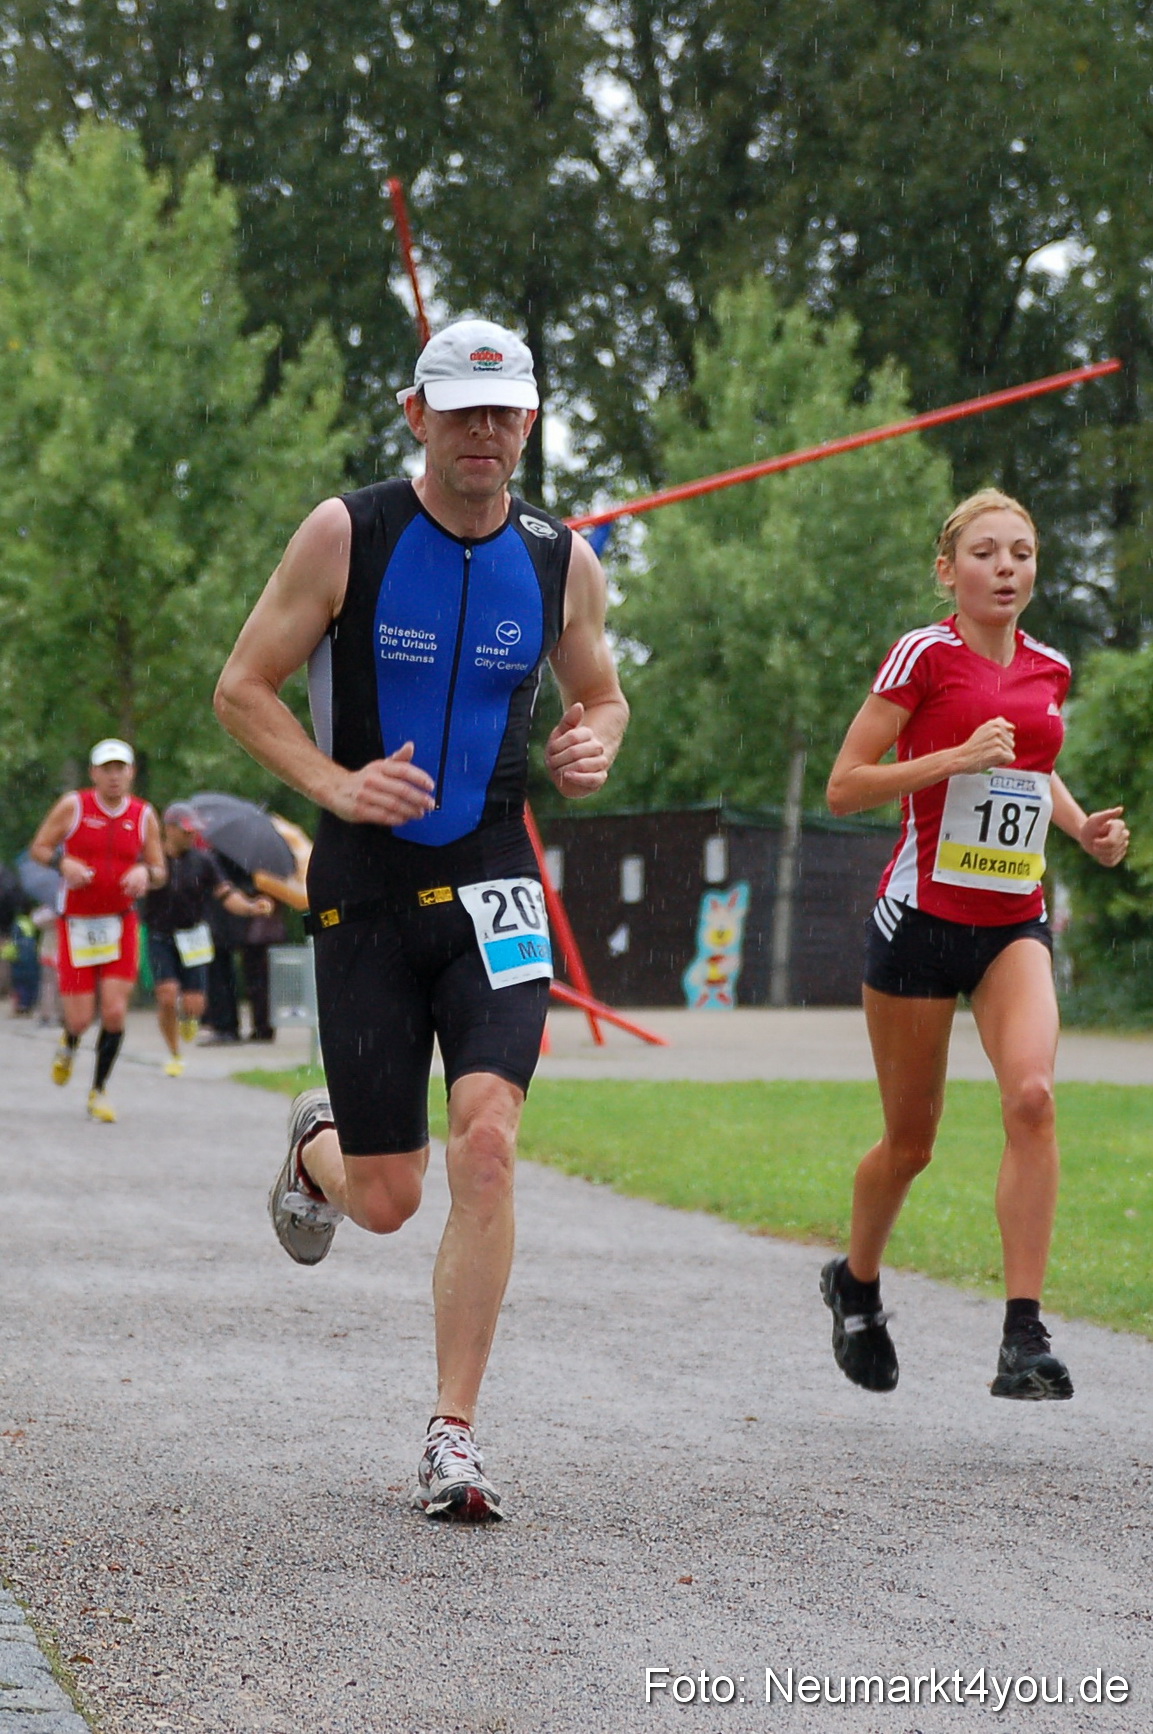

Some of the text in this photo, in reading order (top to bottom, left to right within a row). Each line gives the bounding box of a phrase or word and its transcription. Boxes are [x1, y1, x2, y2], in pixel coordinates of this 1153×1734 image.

[378, 624, 436, 640] Reisebüro
[379, 635, 438, 651] Die Urlaub
[475, 644, 509, 656] sinsel
[380, 649, 435, 664] Lufthansa
[474, 657, 529, 671] City Center
[973, 799, 1041, 848] 187
[481, 885, 546, 934] 20
